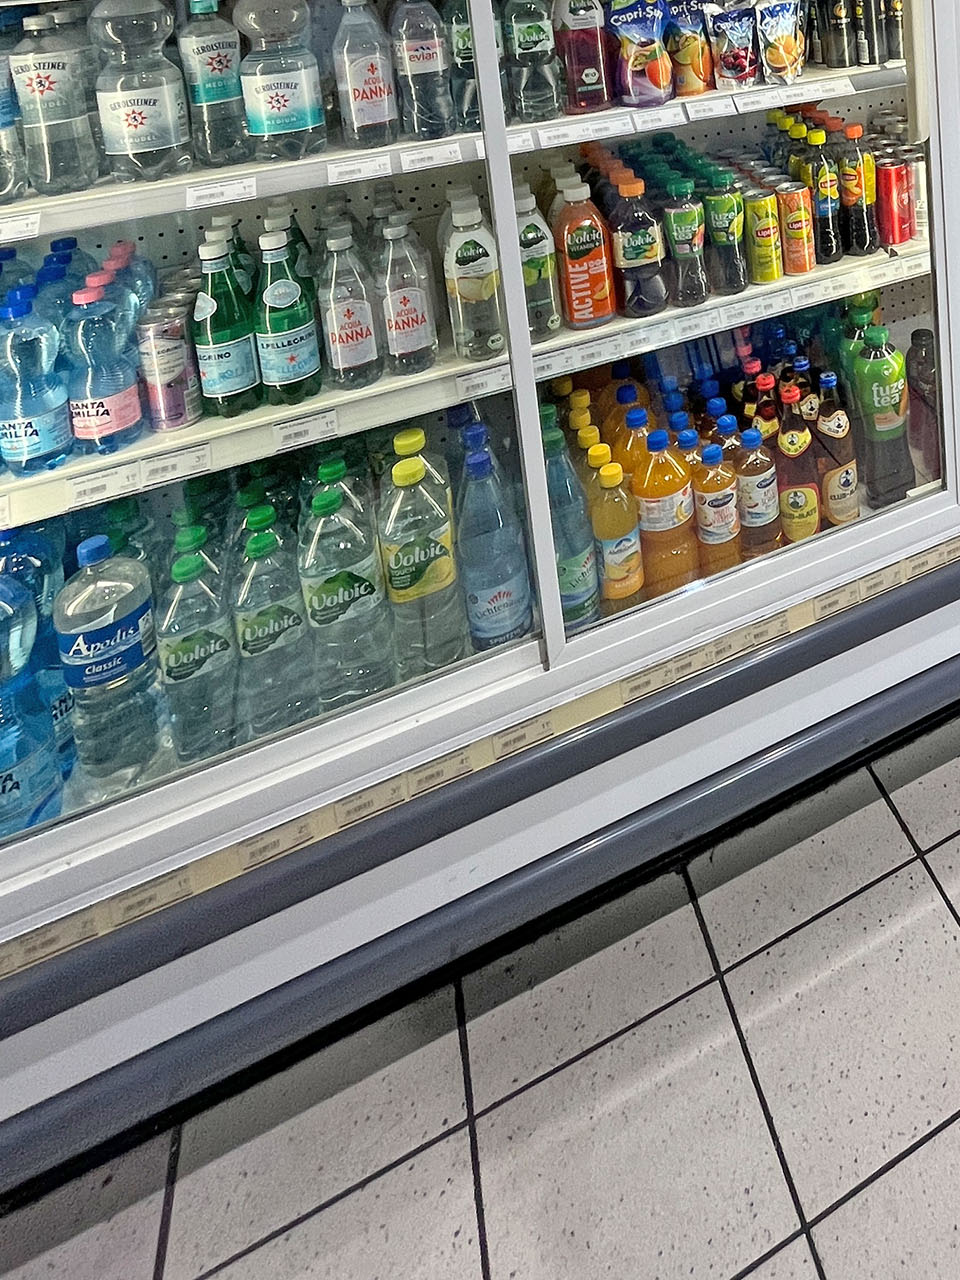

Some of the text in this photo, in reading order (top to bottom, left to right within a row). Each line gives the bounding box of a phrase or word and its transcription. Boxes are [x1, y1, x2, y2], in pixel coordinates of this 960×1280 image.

[610, 5, 664, 26] Capri-Sun
[409, 51, 438, 62] evian
[14, 62, 67, 74] GEROSTEINER
[353, 84, 393, 102] PANNA
[567, 230, 602, 246] Volvic
[624, 234, 655, 248] Volvic
[569, 263, 594, 321] ACTIVE
[387, 313, 428, 332] PANNA
[330, 326, 373, 345] PANNA
[872, 378, 905, 397] fuze
[872, 393, 901, 408] tea
[0, 421, 34, 431] ANTA
[0, 428, 40, 439] MILIA
[388, 543, 447, 570] Volvic
[312, 581, 372, 611] Volvic
[245, 612, 299, 641] Volvic
[69, 625, 136, 658] Apodis
[168, 639, 224, 669] Volvic
[85, 656, 122, 675] Classic
